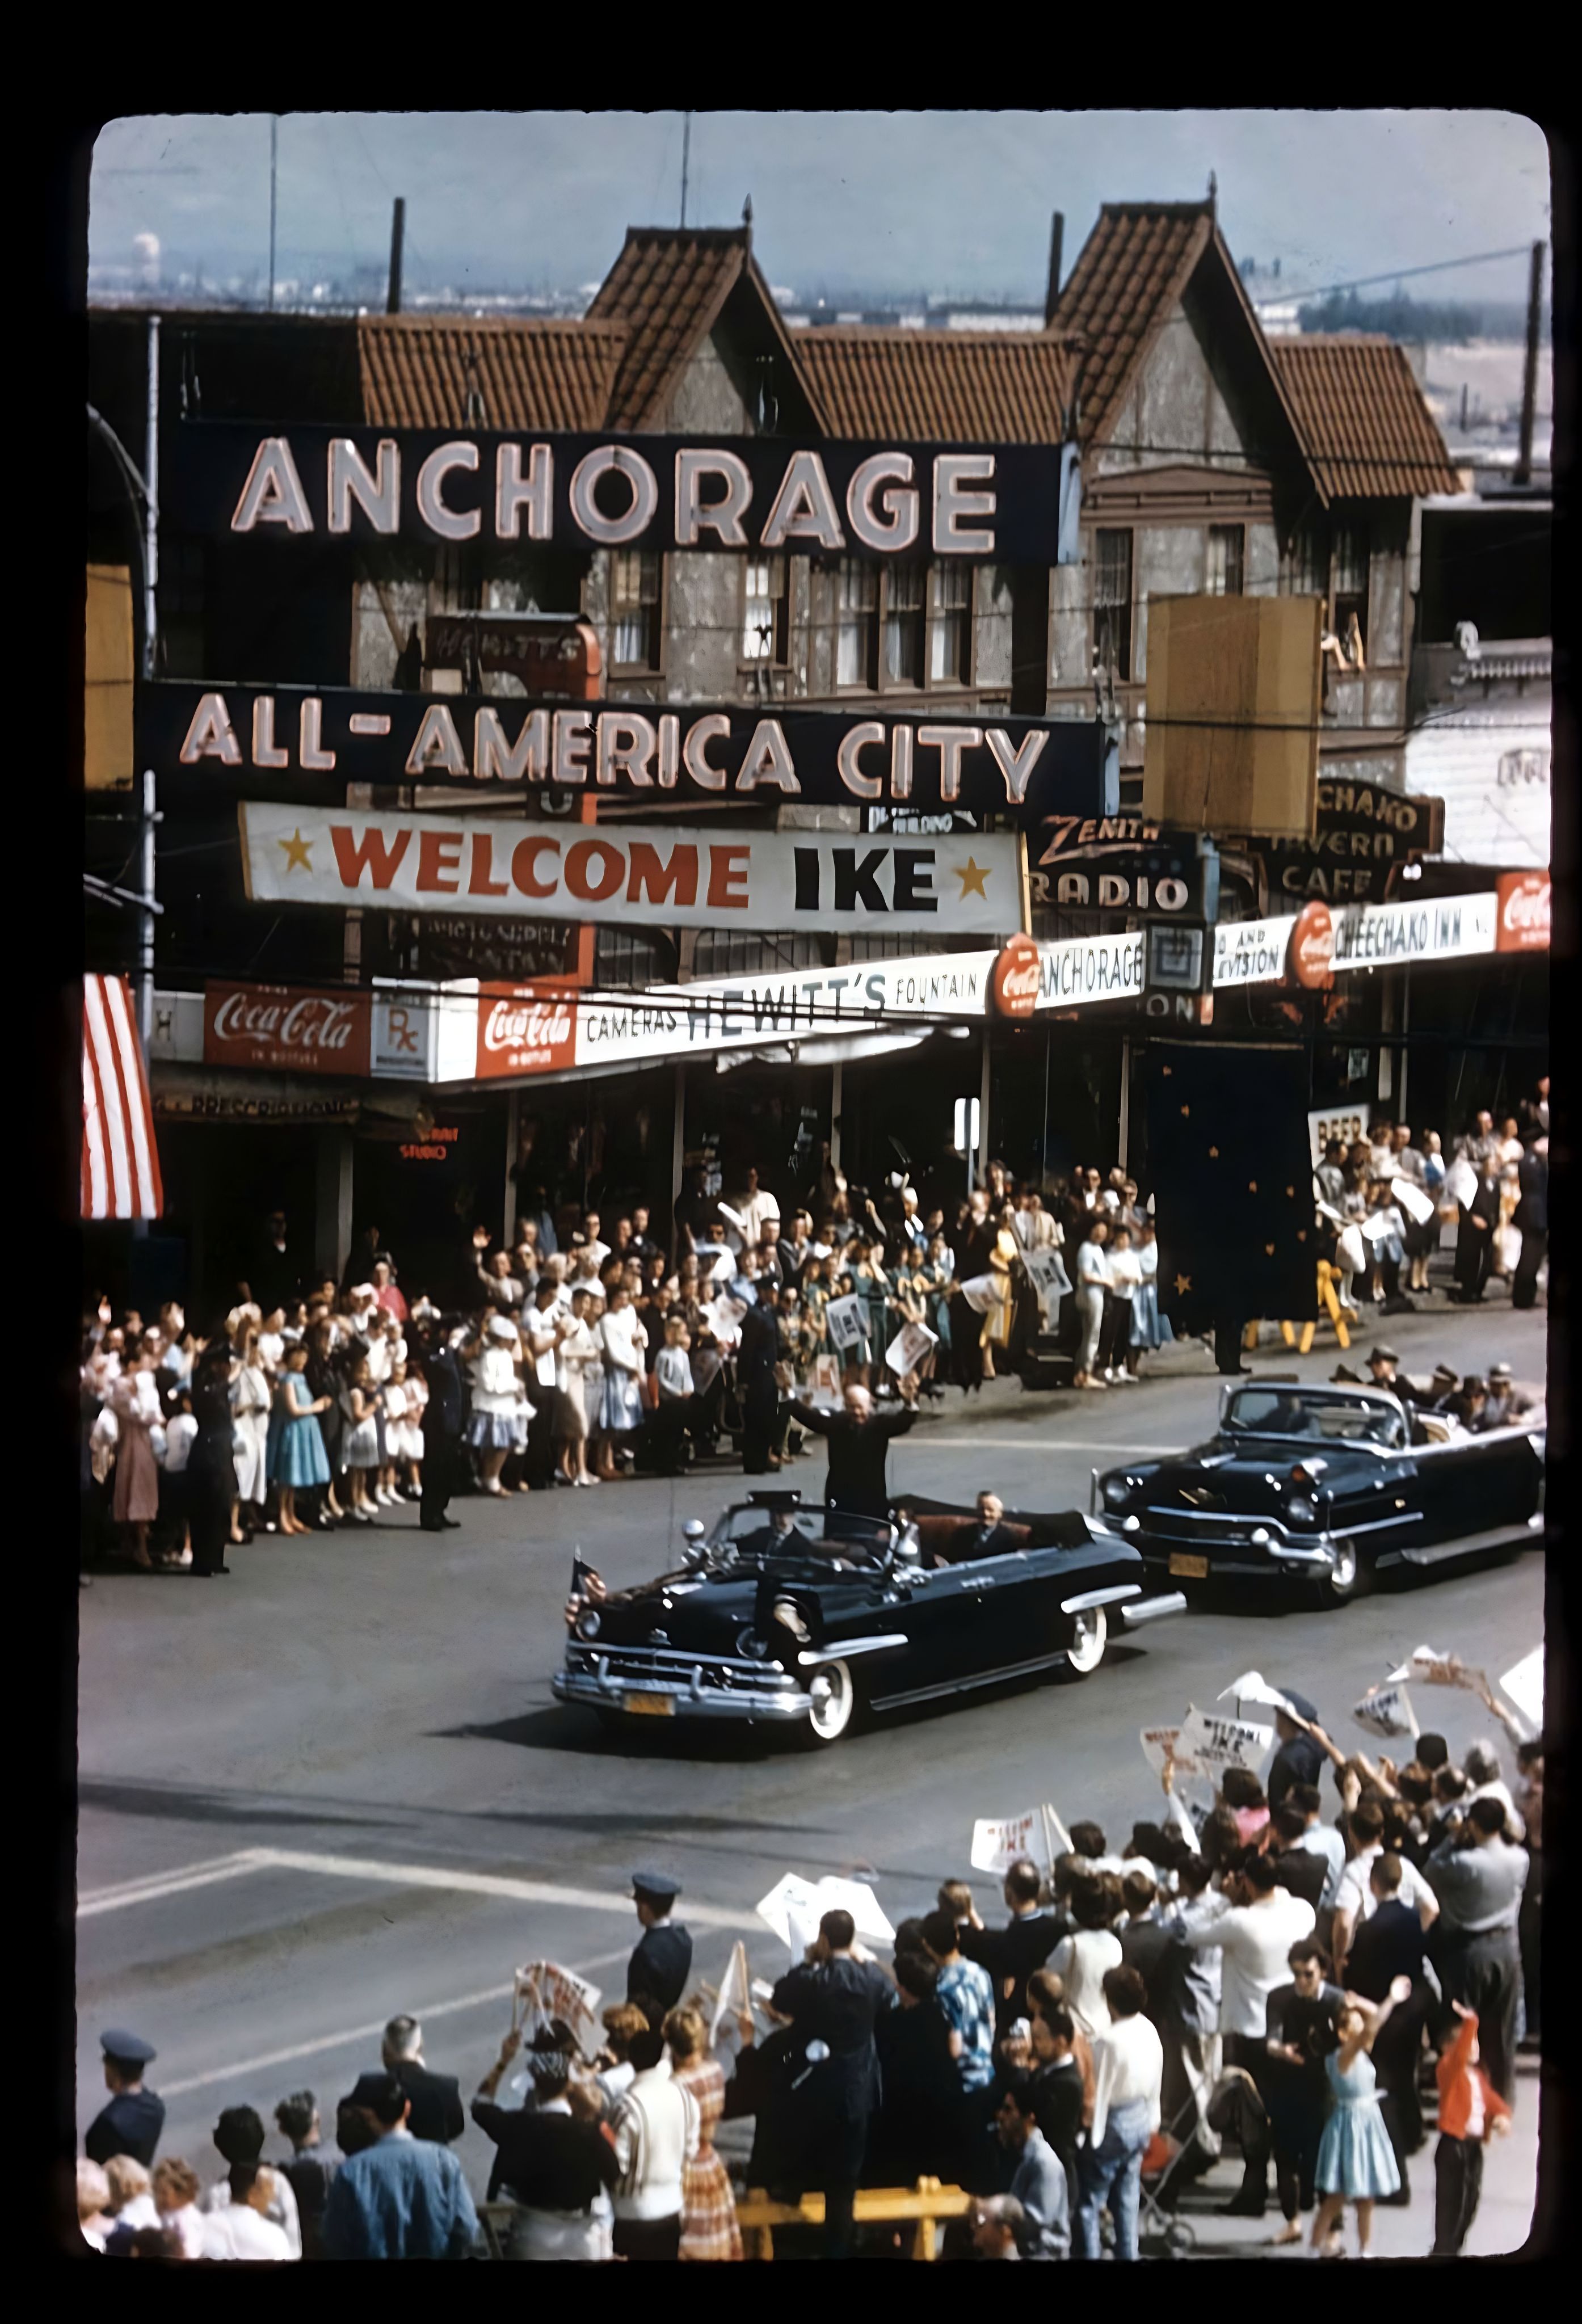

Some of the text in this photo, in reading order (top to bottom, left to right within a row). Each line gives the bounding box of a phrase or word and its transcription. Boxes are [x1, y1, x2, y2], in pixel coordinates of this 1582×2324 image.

[232, 436, 996, 554] ANCHORAGE
[179, 693, 1050, 803] ALL-AMERICA CITY
[330, 825, 938, 913] WELCOME IKE
[1029, 872, 1188, 911] RADIO
[1236, 928, 1265, 949] AND
[1433, 907, 1461, 950] INN
[587, 972, 977, 1042] CAMERAS HEWITT'S FOUNTAIN
